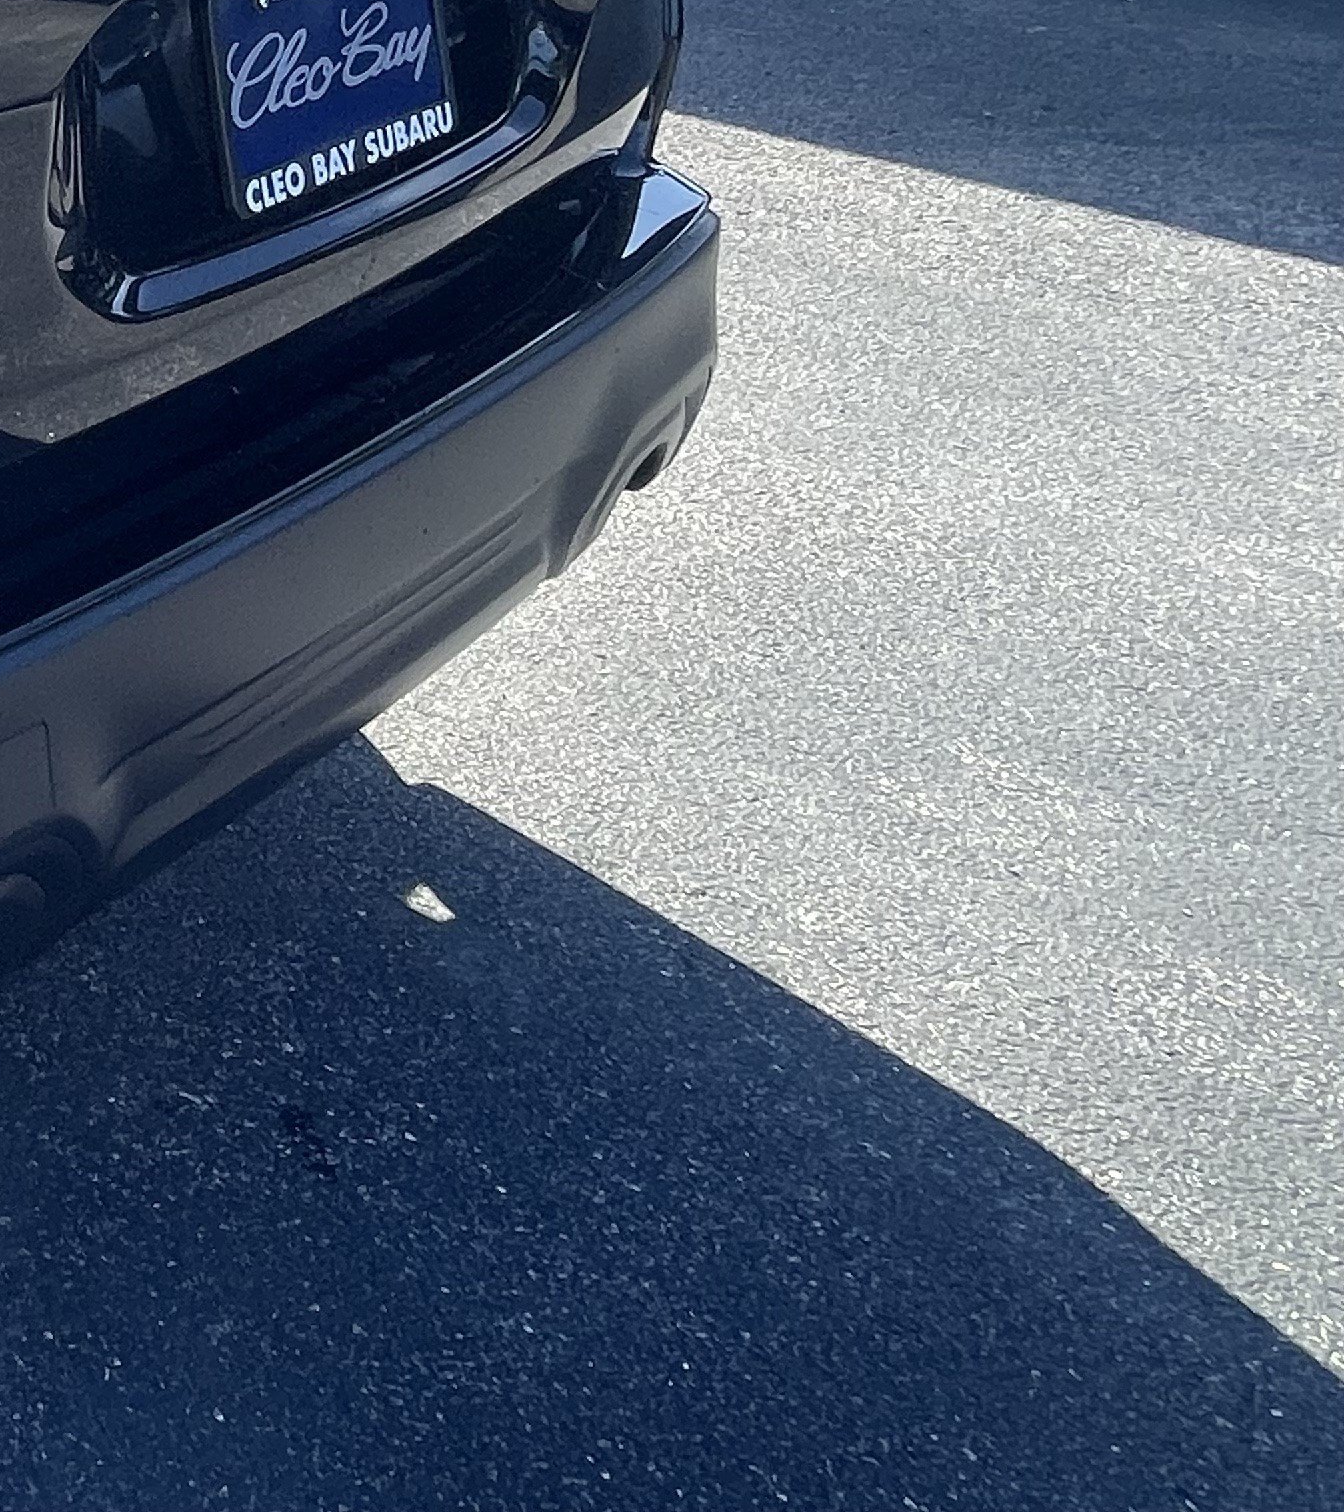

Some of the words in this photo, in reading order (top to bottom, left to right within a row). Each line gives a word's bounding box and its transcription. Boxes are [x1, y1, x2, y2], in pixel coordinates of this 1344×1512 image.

[226, 28, 342, 129] Cleo
[340, 0, 432, 87] Bay
[245, 162, 306, 213] CLEO
[311, 138, 356, 186] BAY
[364, 101, 454, 164] SUBARU
